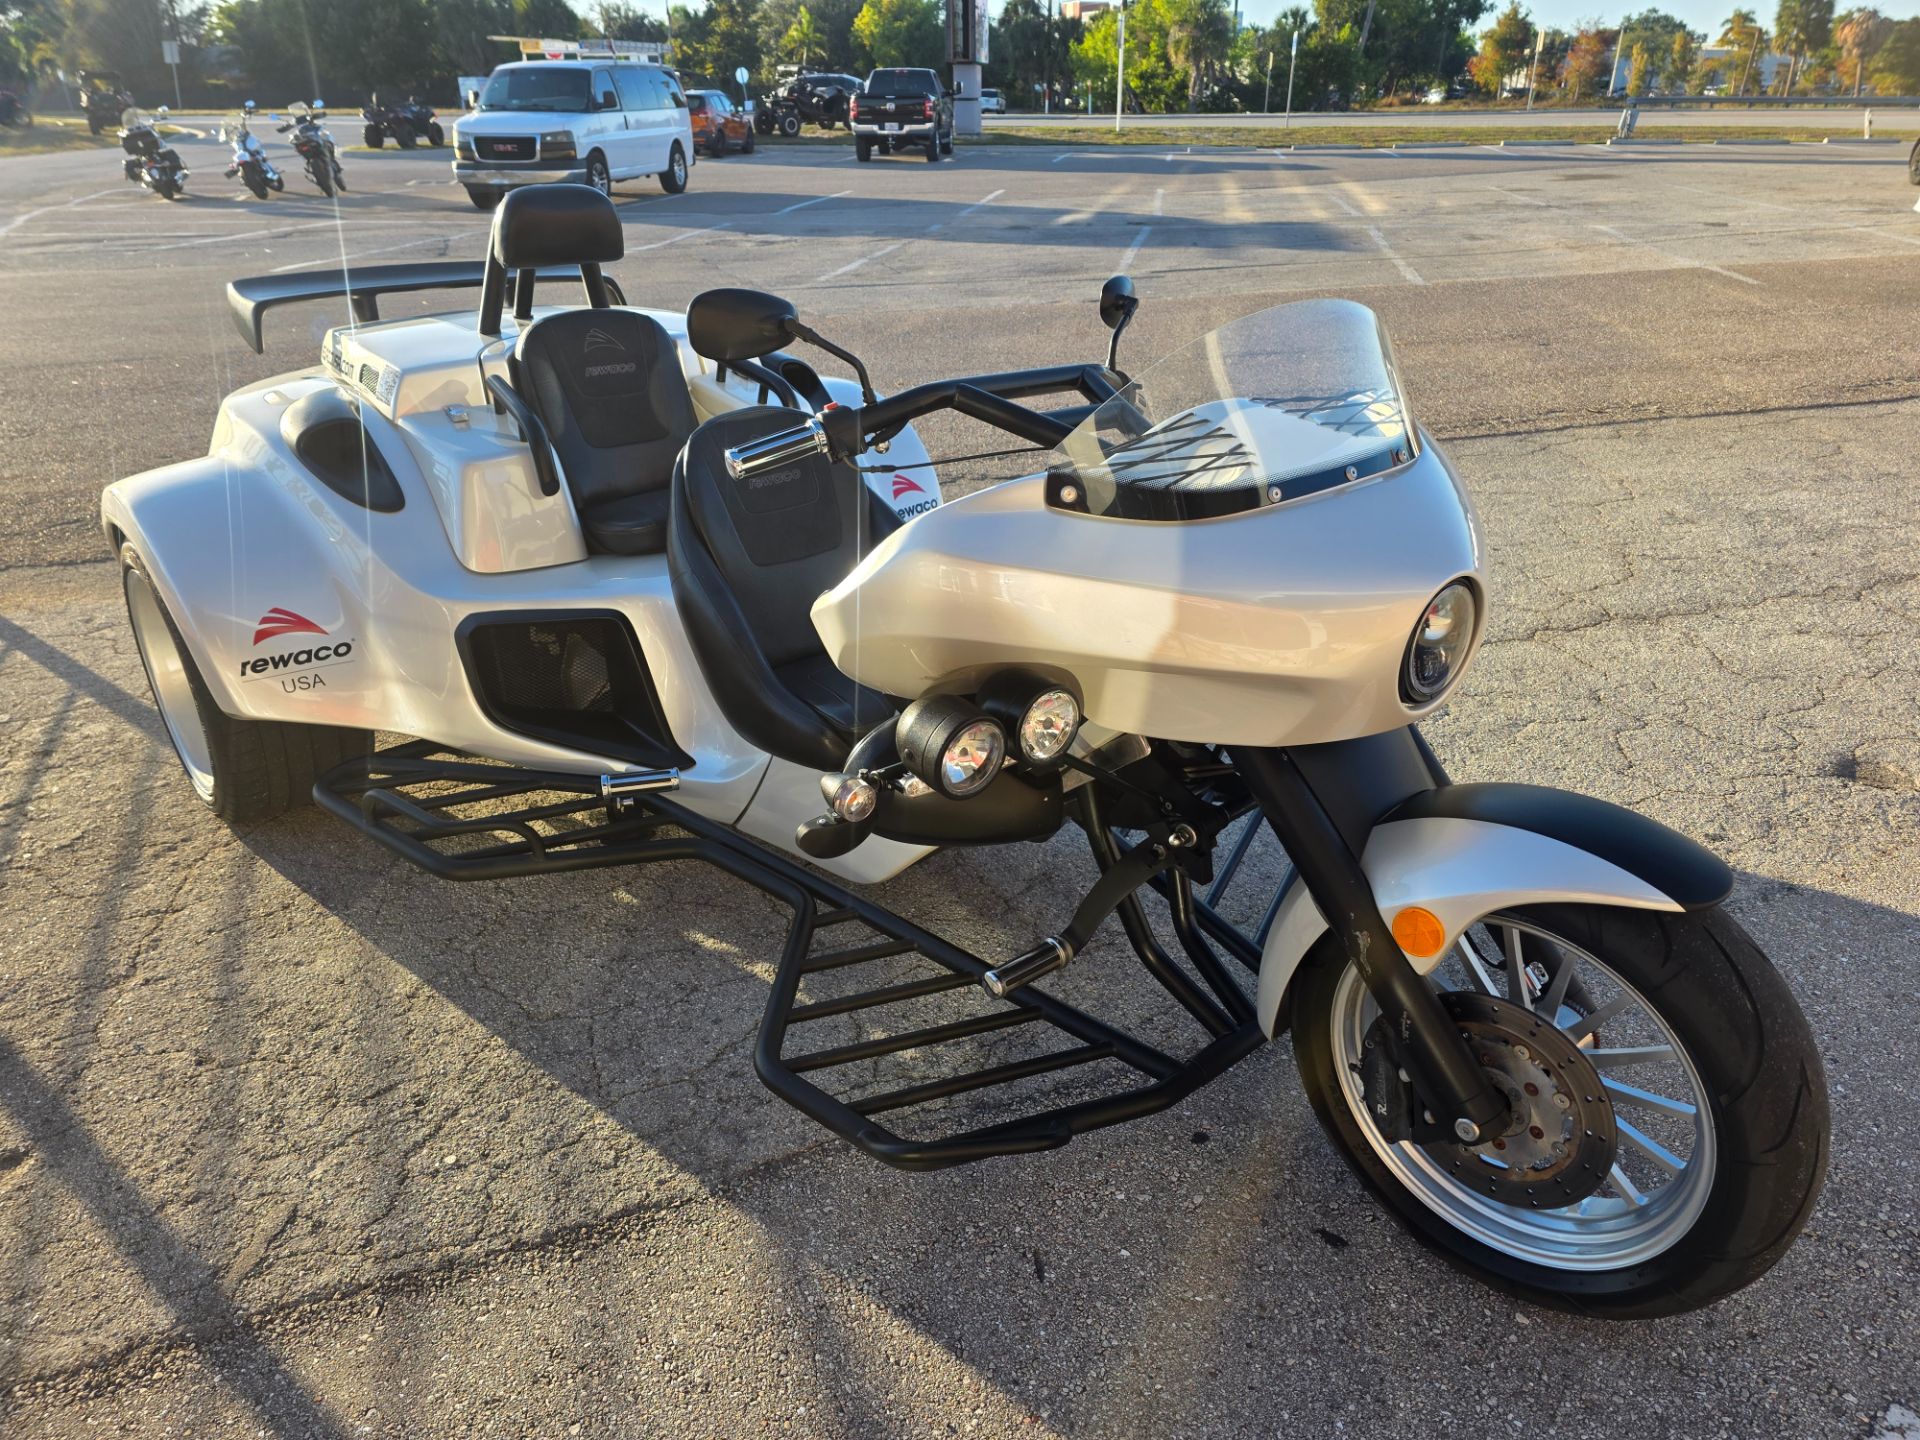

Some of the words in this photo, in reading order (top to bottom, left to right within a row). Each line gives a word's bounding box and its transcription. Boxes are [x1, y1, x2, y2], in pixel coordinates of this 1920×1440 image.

[493, 144, 519, 152] GMC
[585, 362, 637, 377] rewaco
[897, 498, 939, 519] ewaco
[240, 641, 353, 677] rewaco
[282, 673, 326, 694] USA
